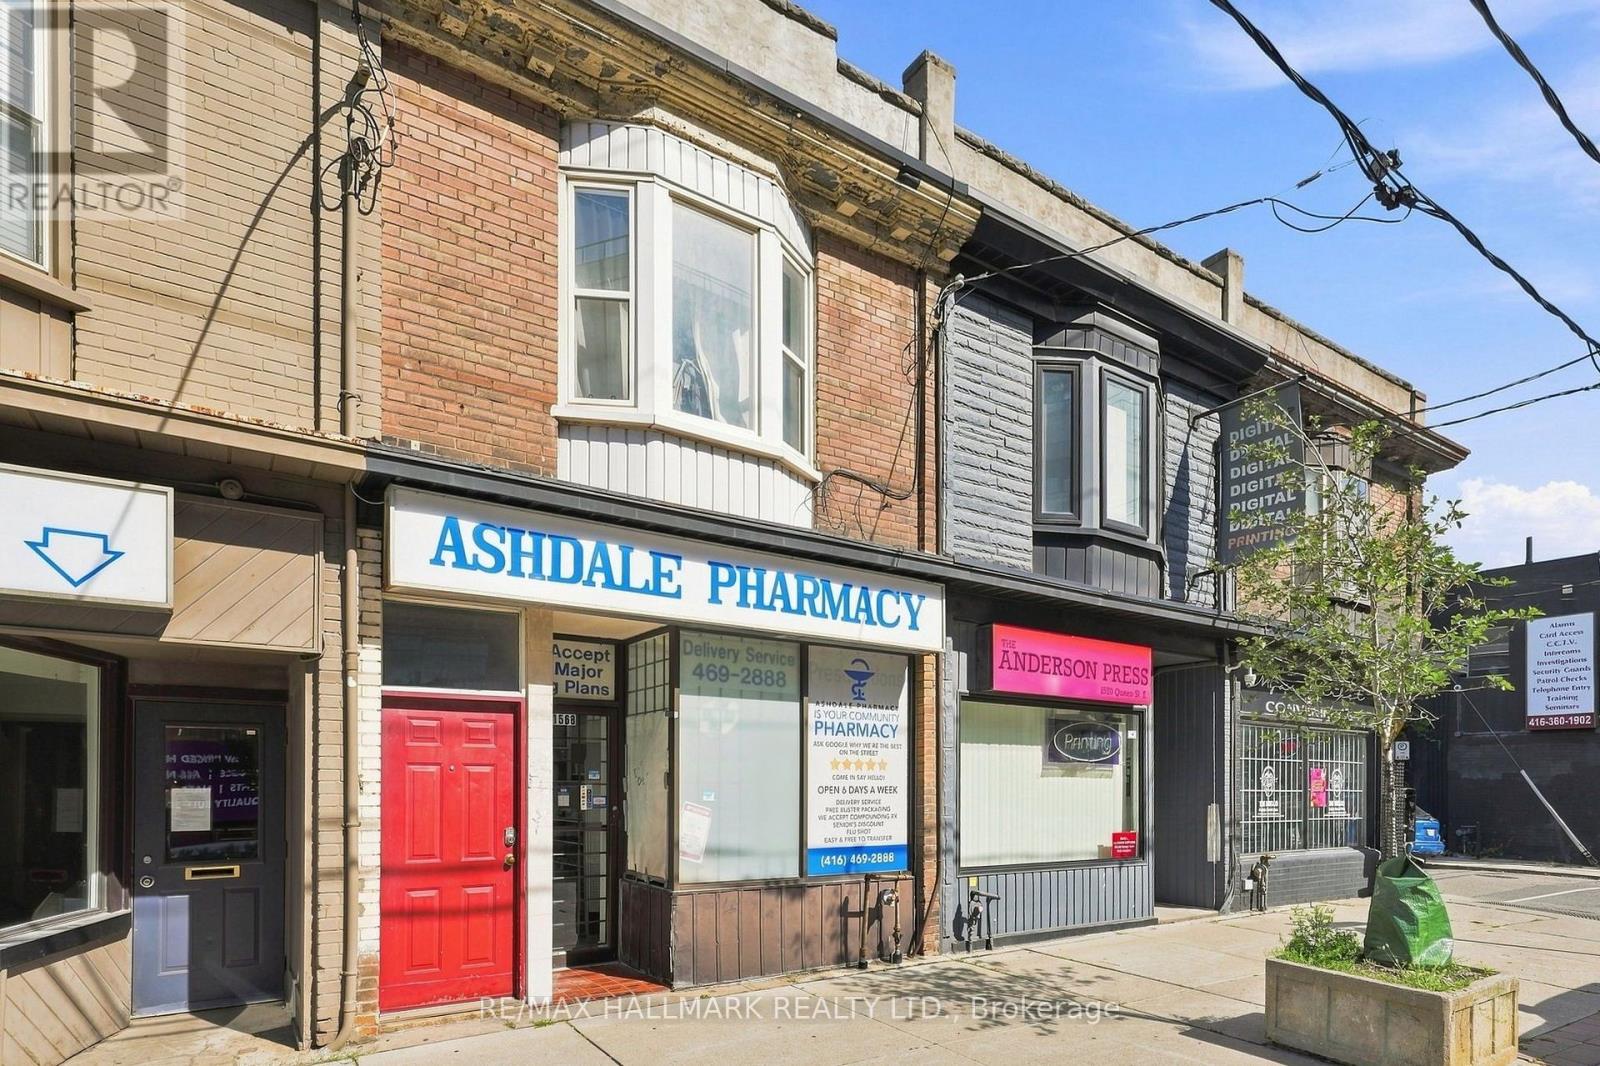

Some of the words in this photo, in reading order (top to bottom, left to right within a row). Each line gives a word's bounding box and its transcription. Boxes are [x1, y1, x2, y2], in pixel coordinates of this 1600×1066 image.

[1230, 416, 1292, 443] DIGIT
[1230, 453, 1295, 479] DIGIAL
[1230, 471, 1296, 497] DIGITA
[1230, 487, 1297, 514] DIGITAL
[429, 515, 682, 599] ASHDALE
[707, 560, 925, 631] PHARMACY
[1001, 638, 1017, 649] THE
[553, 644, 610, 664] Accept
[682, 638, 740, 663] Delivery
[745, 646, 796, 667] Service
[998, 650, 1098, 681] ANDERSON
[1102, 663, 1149, 686] PRESS
[1537, 657, 1588, 666] Investigations
[555, 662, 603, 679] Major
[692, 663, 787, 688] 469-2888
[1533, 668, 1561, 676] Security
[565, 680, 609, 696] Plans
[1532, 686, 1570, 694] Telephone
[815, 700, 853, 708] ASHDALE
[856, 702, 898, 711] PHARMACY
[814, 709, 821, 719] IS
[823, 710, 847, 720] YOUR
[849, 711, 899, 722] COMMUNITY
[1529, 715, 1591, 726] 416-360-1902
[814, 720, 898, 738] PHARMACY
[1064, 733, 1112, 755] Printing
[860, 749, 879, 757] STREET
[817, 785, 840, 795] OPEN
[842, 786, 847, 794] 6
[849, 785, 869, 794] DAYS
[870, 786, 876, 794] A
[877, 785, 898, 794] WEEK
[818, 813, 827, 821] WE
[828, 813, 848, 821] ACCEPT
[820, 855, 847, 868] (416)
[849, 852, 895, 865] 469-2888
